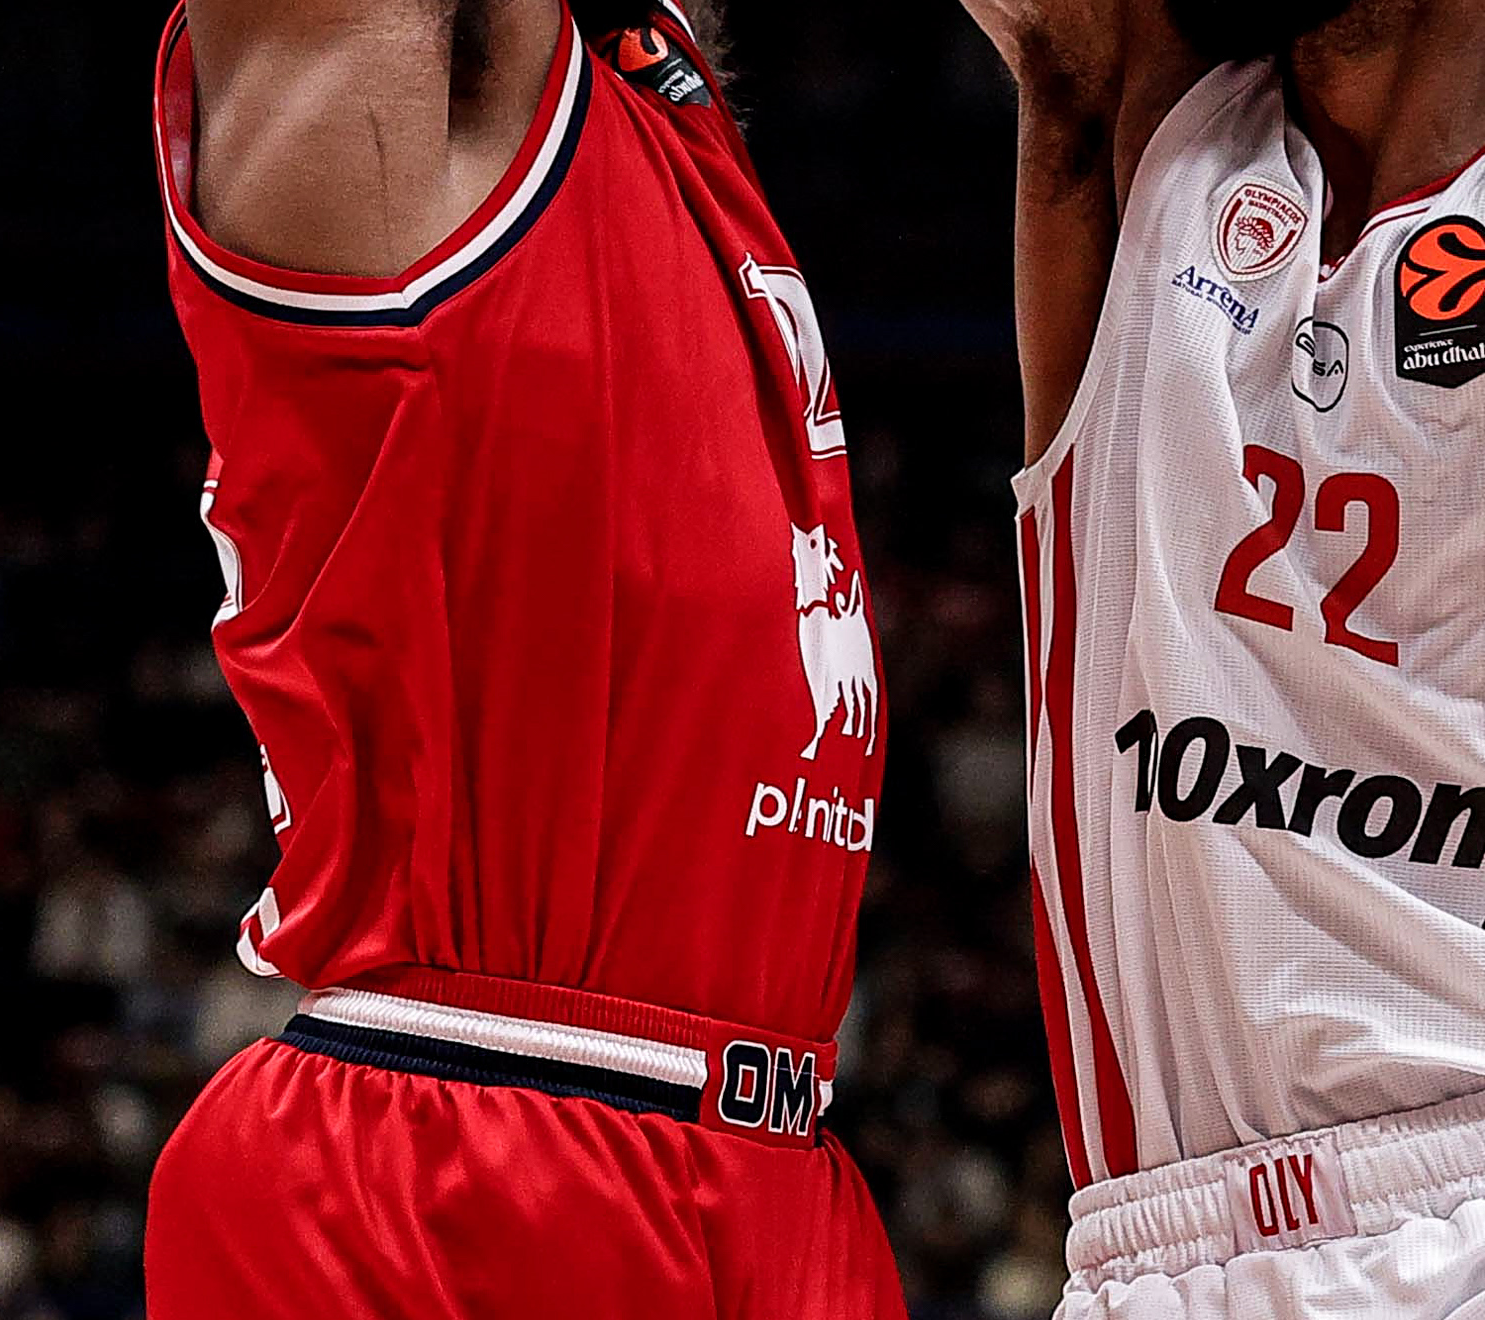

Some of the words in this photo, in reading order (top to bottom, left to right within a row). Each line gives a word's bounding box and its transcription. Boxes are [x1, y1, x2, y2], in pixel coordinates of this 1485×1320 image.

[1244, 189, 1302, 225] OLYMPIACOS
[1403, 352, 1440, 370] abu
[1404, 339, 1454, 352] experience
[1215, 444, 1400, 667] 22
[718, 1040, 816, 1136] OM
[1249, 1152, 1319, 1237] OLY
